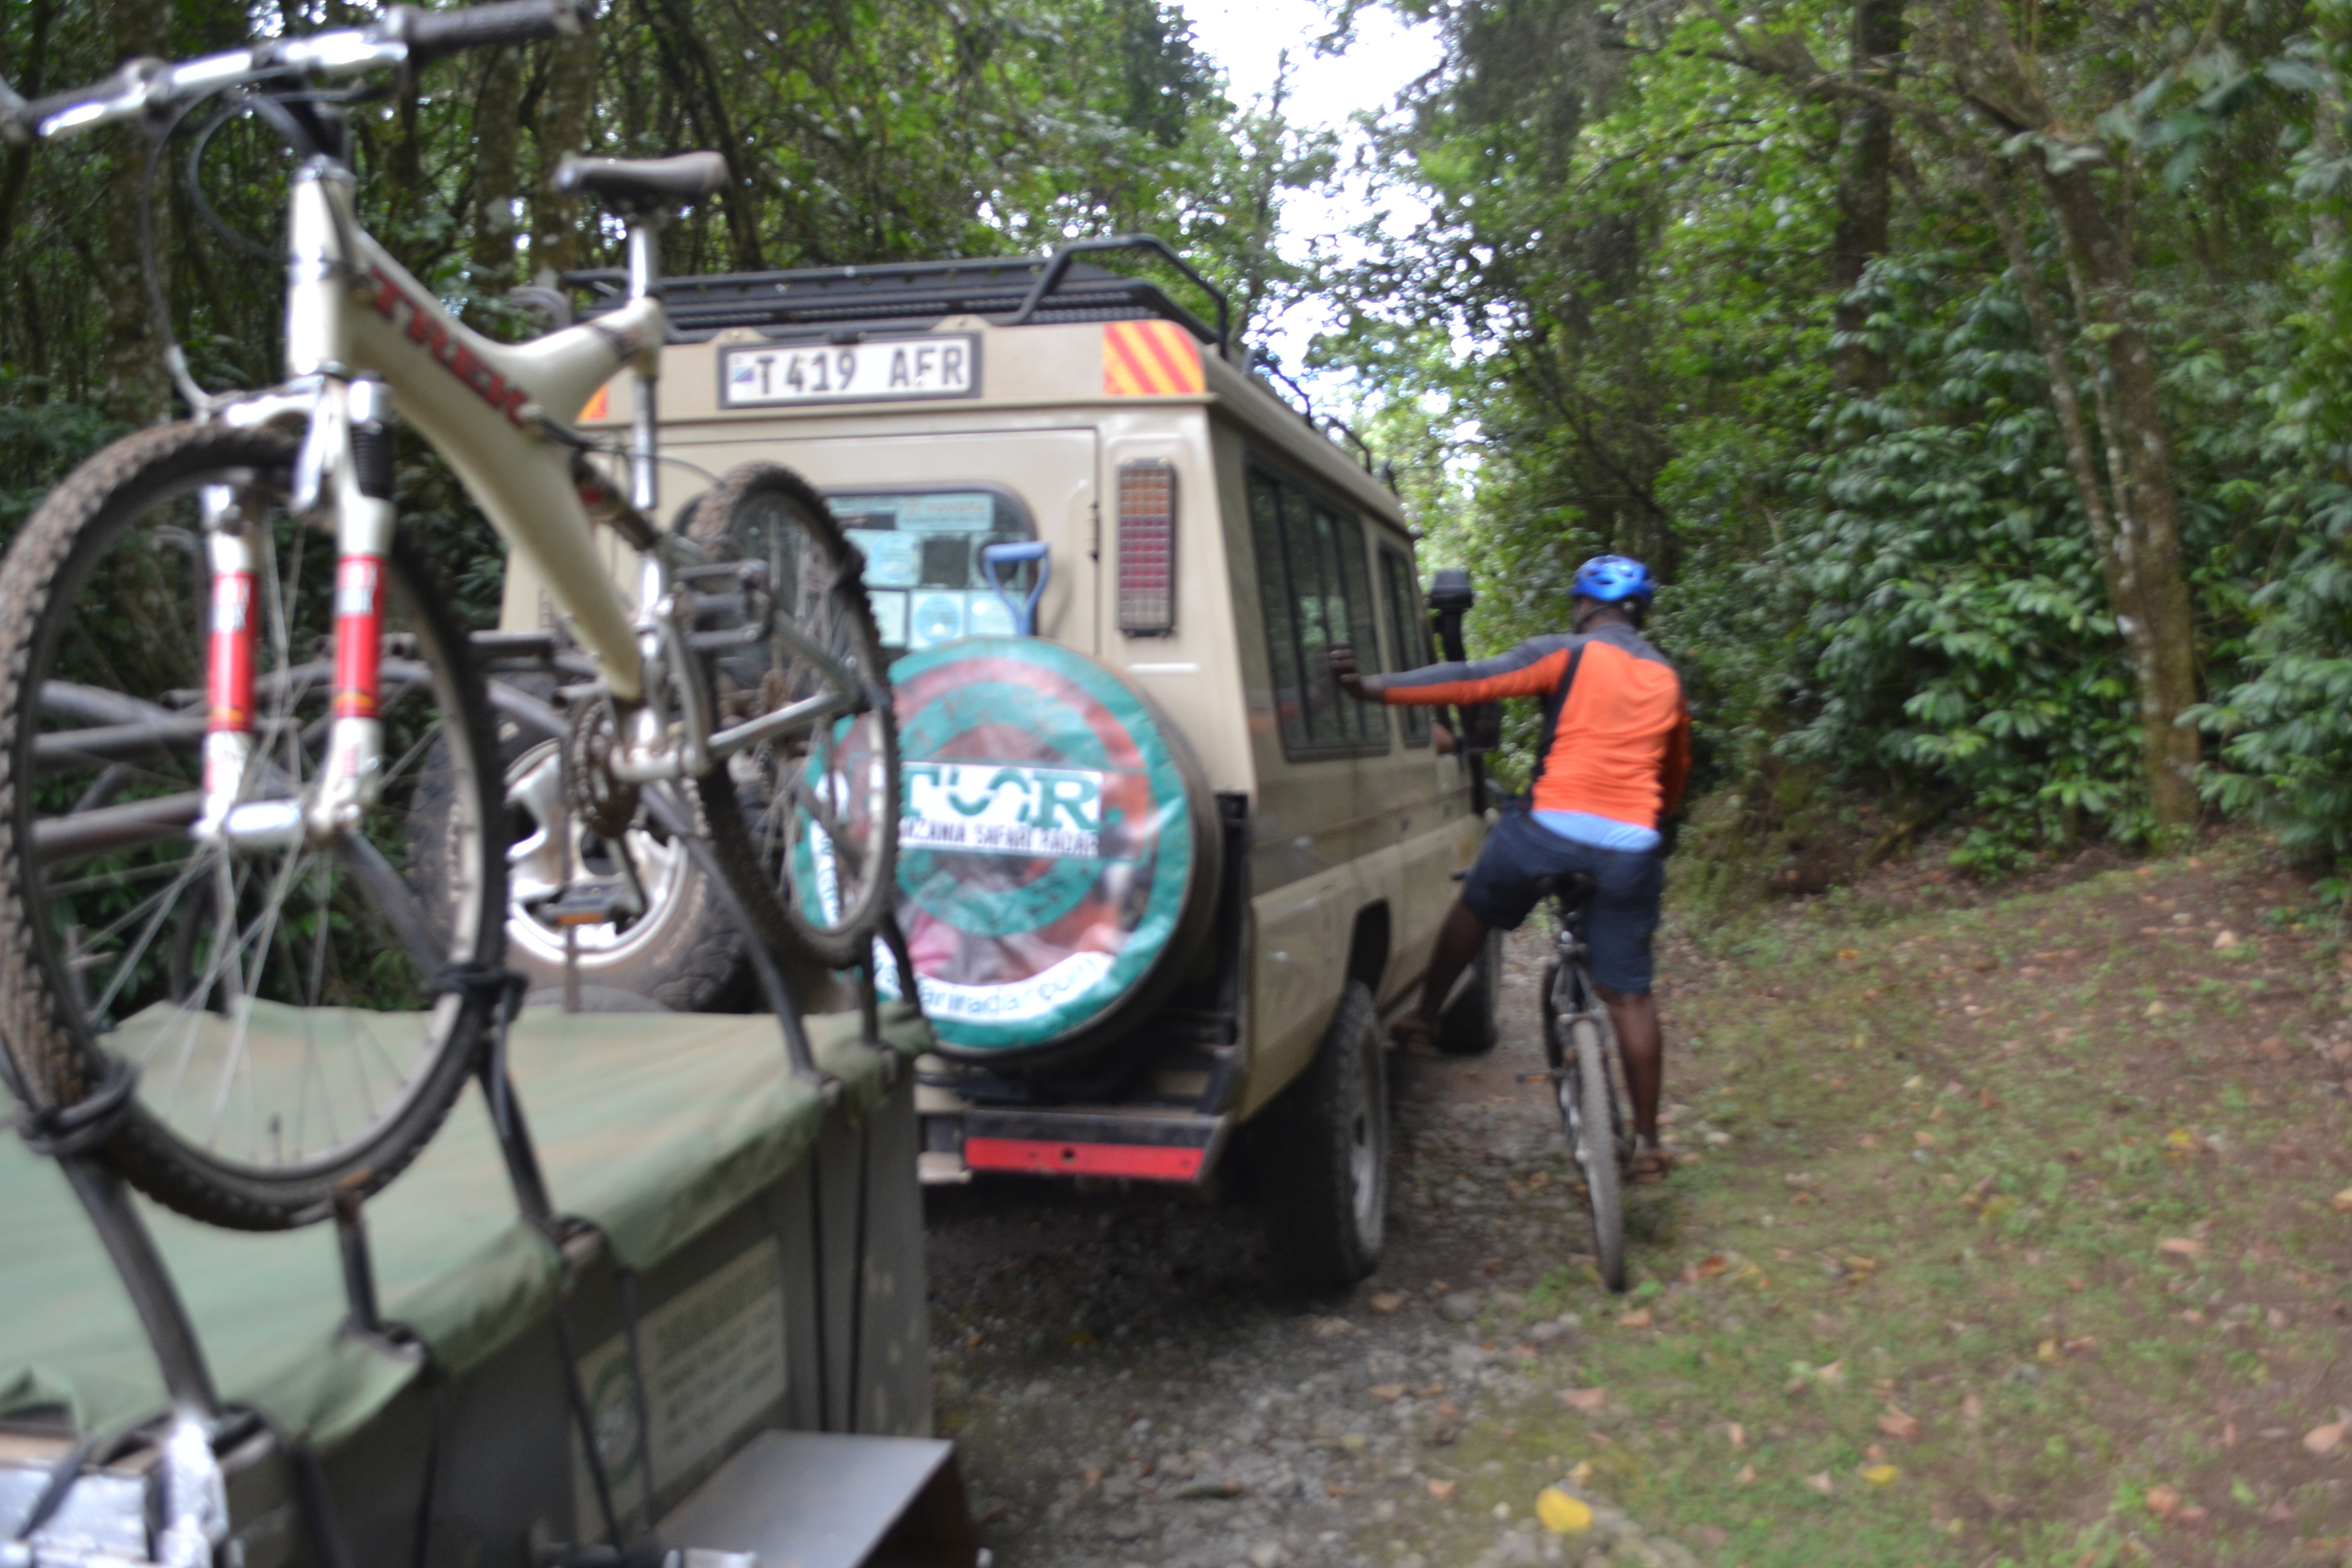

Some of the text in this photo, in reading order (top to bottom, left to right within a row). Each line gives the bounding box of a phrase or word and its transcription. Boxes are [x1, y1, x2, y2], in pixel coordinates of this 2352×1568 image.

[370, 264, 529, 429] TREK
[756, 346, 963, 395] T419 AFR
[974, 822, 1032, 848] SAFARI
